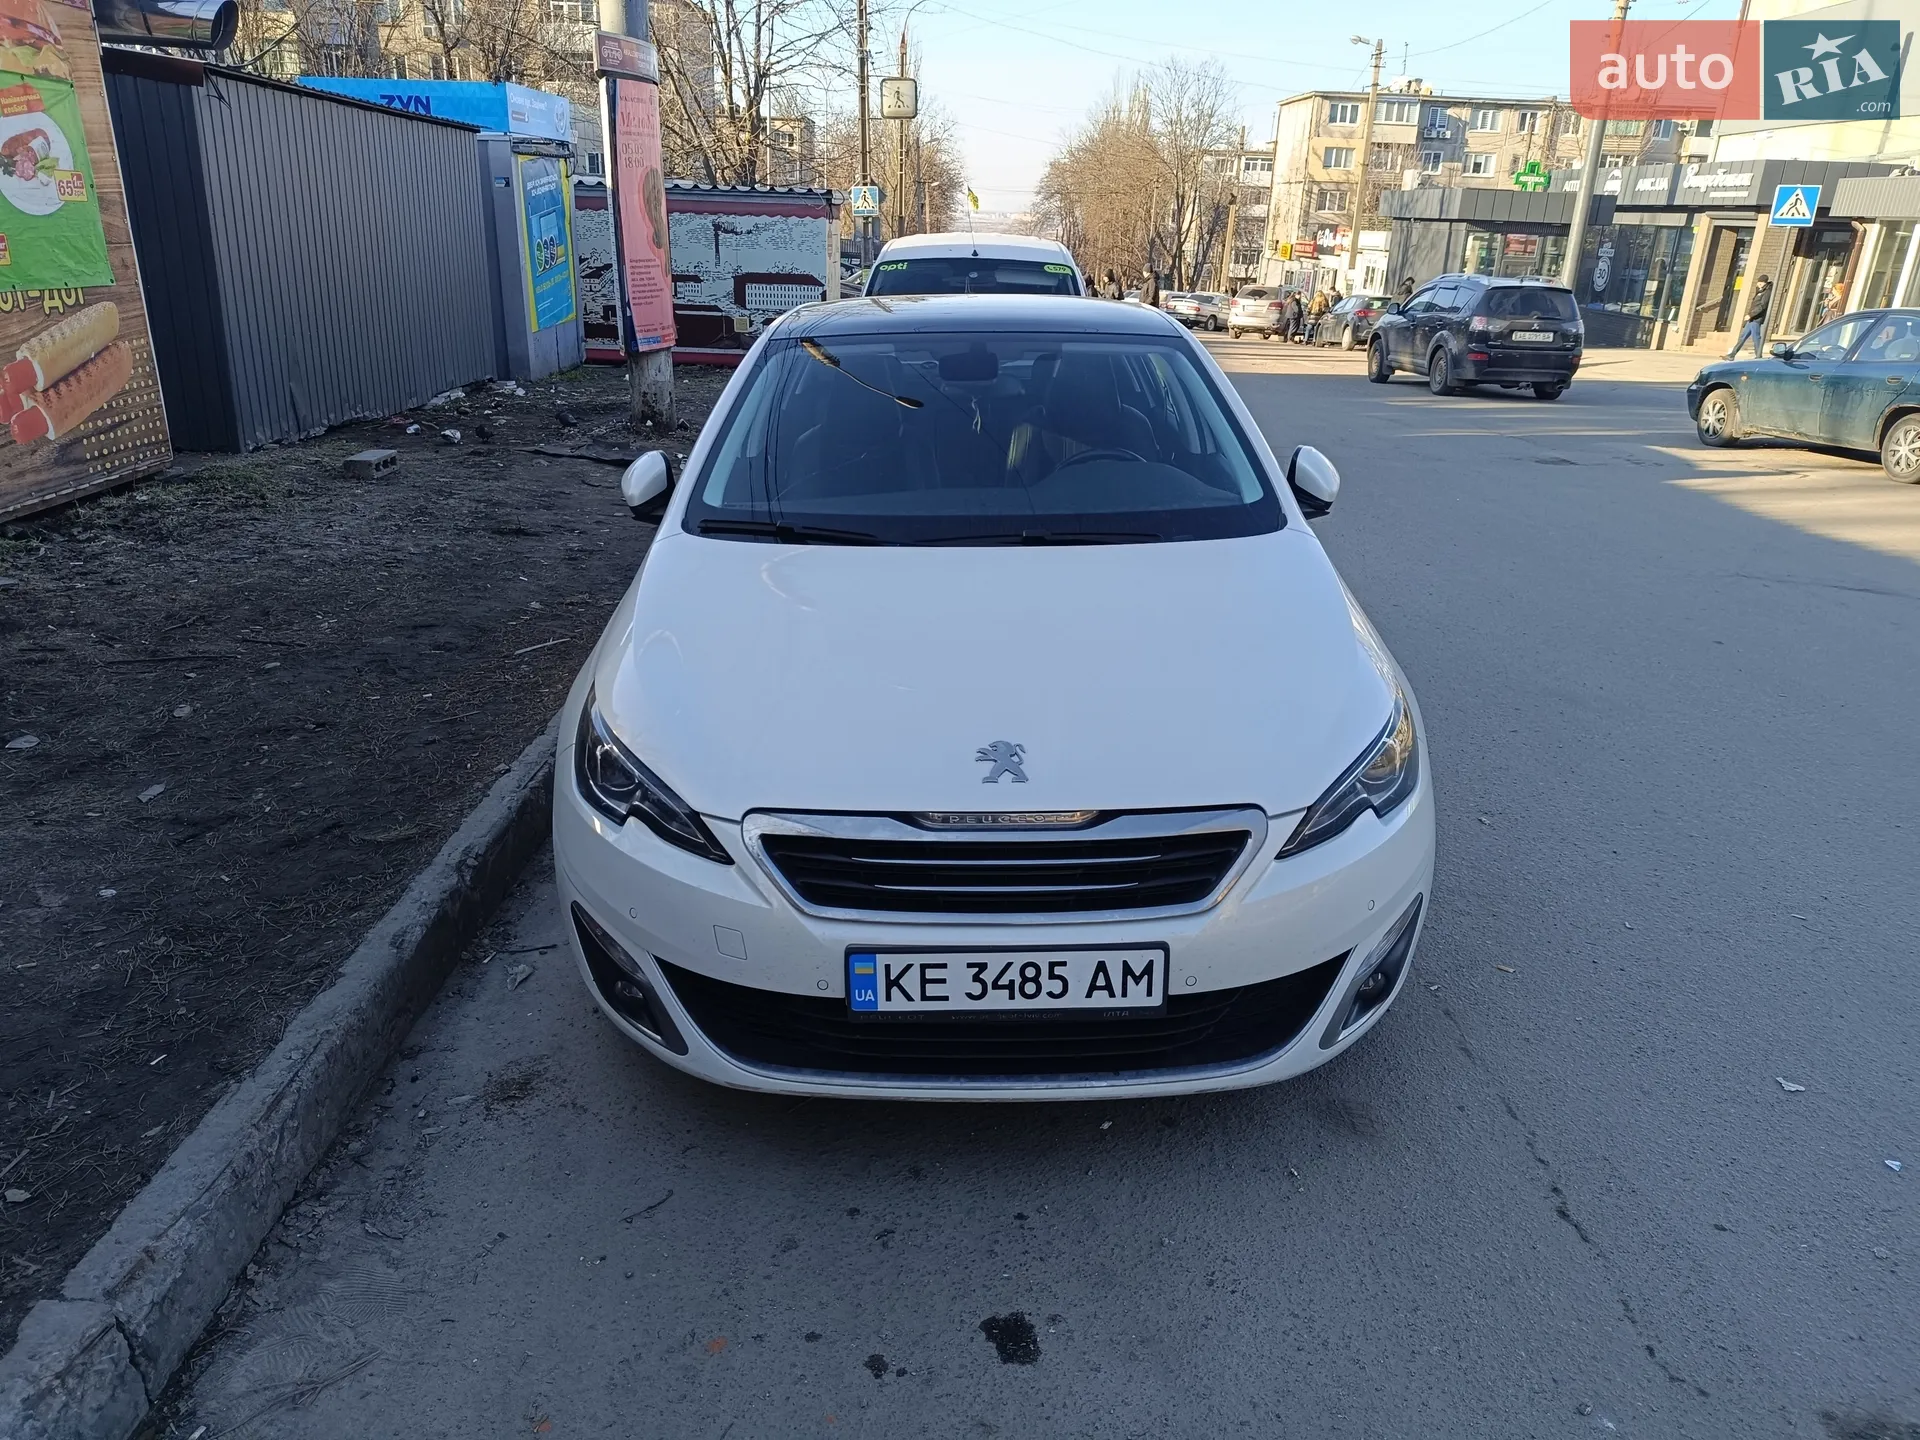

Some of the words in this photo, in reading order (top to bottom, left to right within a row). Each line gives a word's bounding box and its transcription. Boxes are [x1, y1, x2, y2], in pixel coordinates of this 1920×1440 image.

[58, 179, 73, 196] 65
[879, 261, 909, 272] opti
[884, 962, 950, 1002] KE
[964, 960, 1070, 1000] 3485
[1085, 958, 1155, 999] AM
[855, 989, 875, 1001] UA
